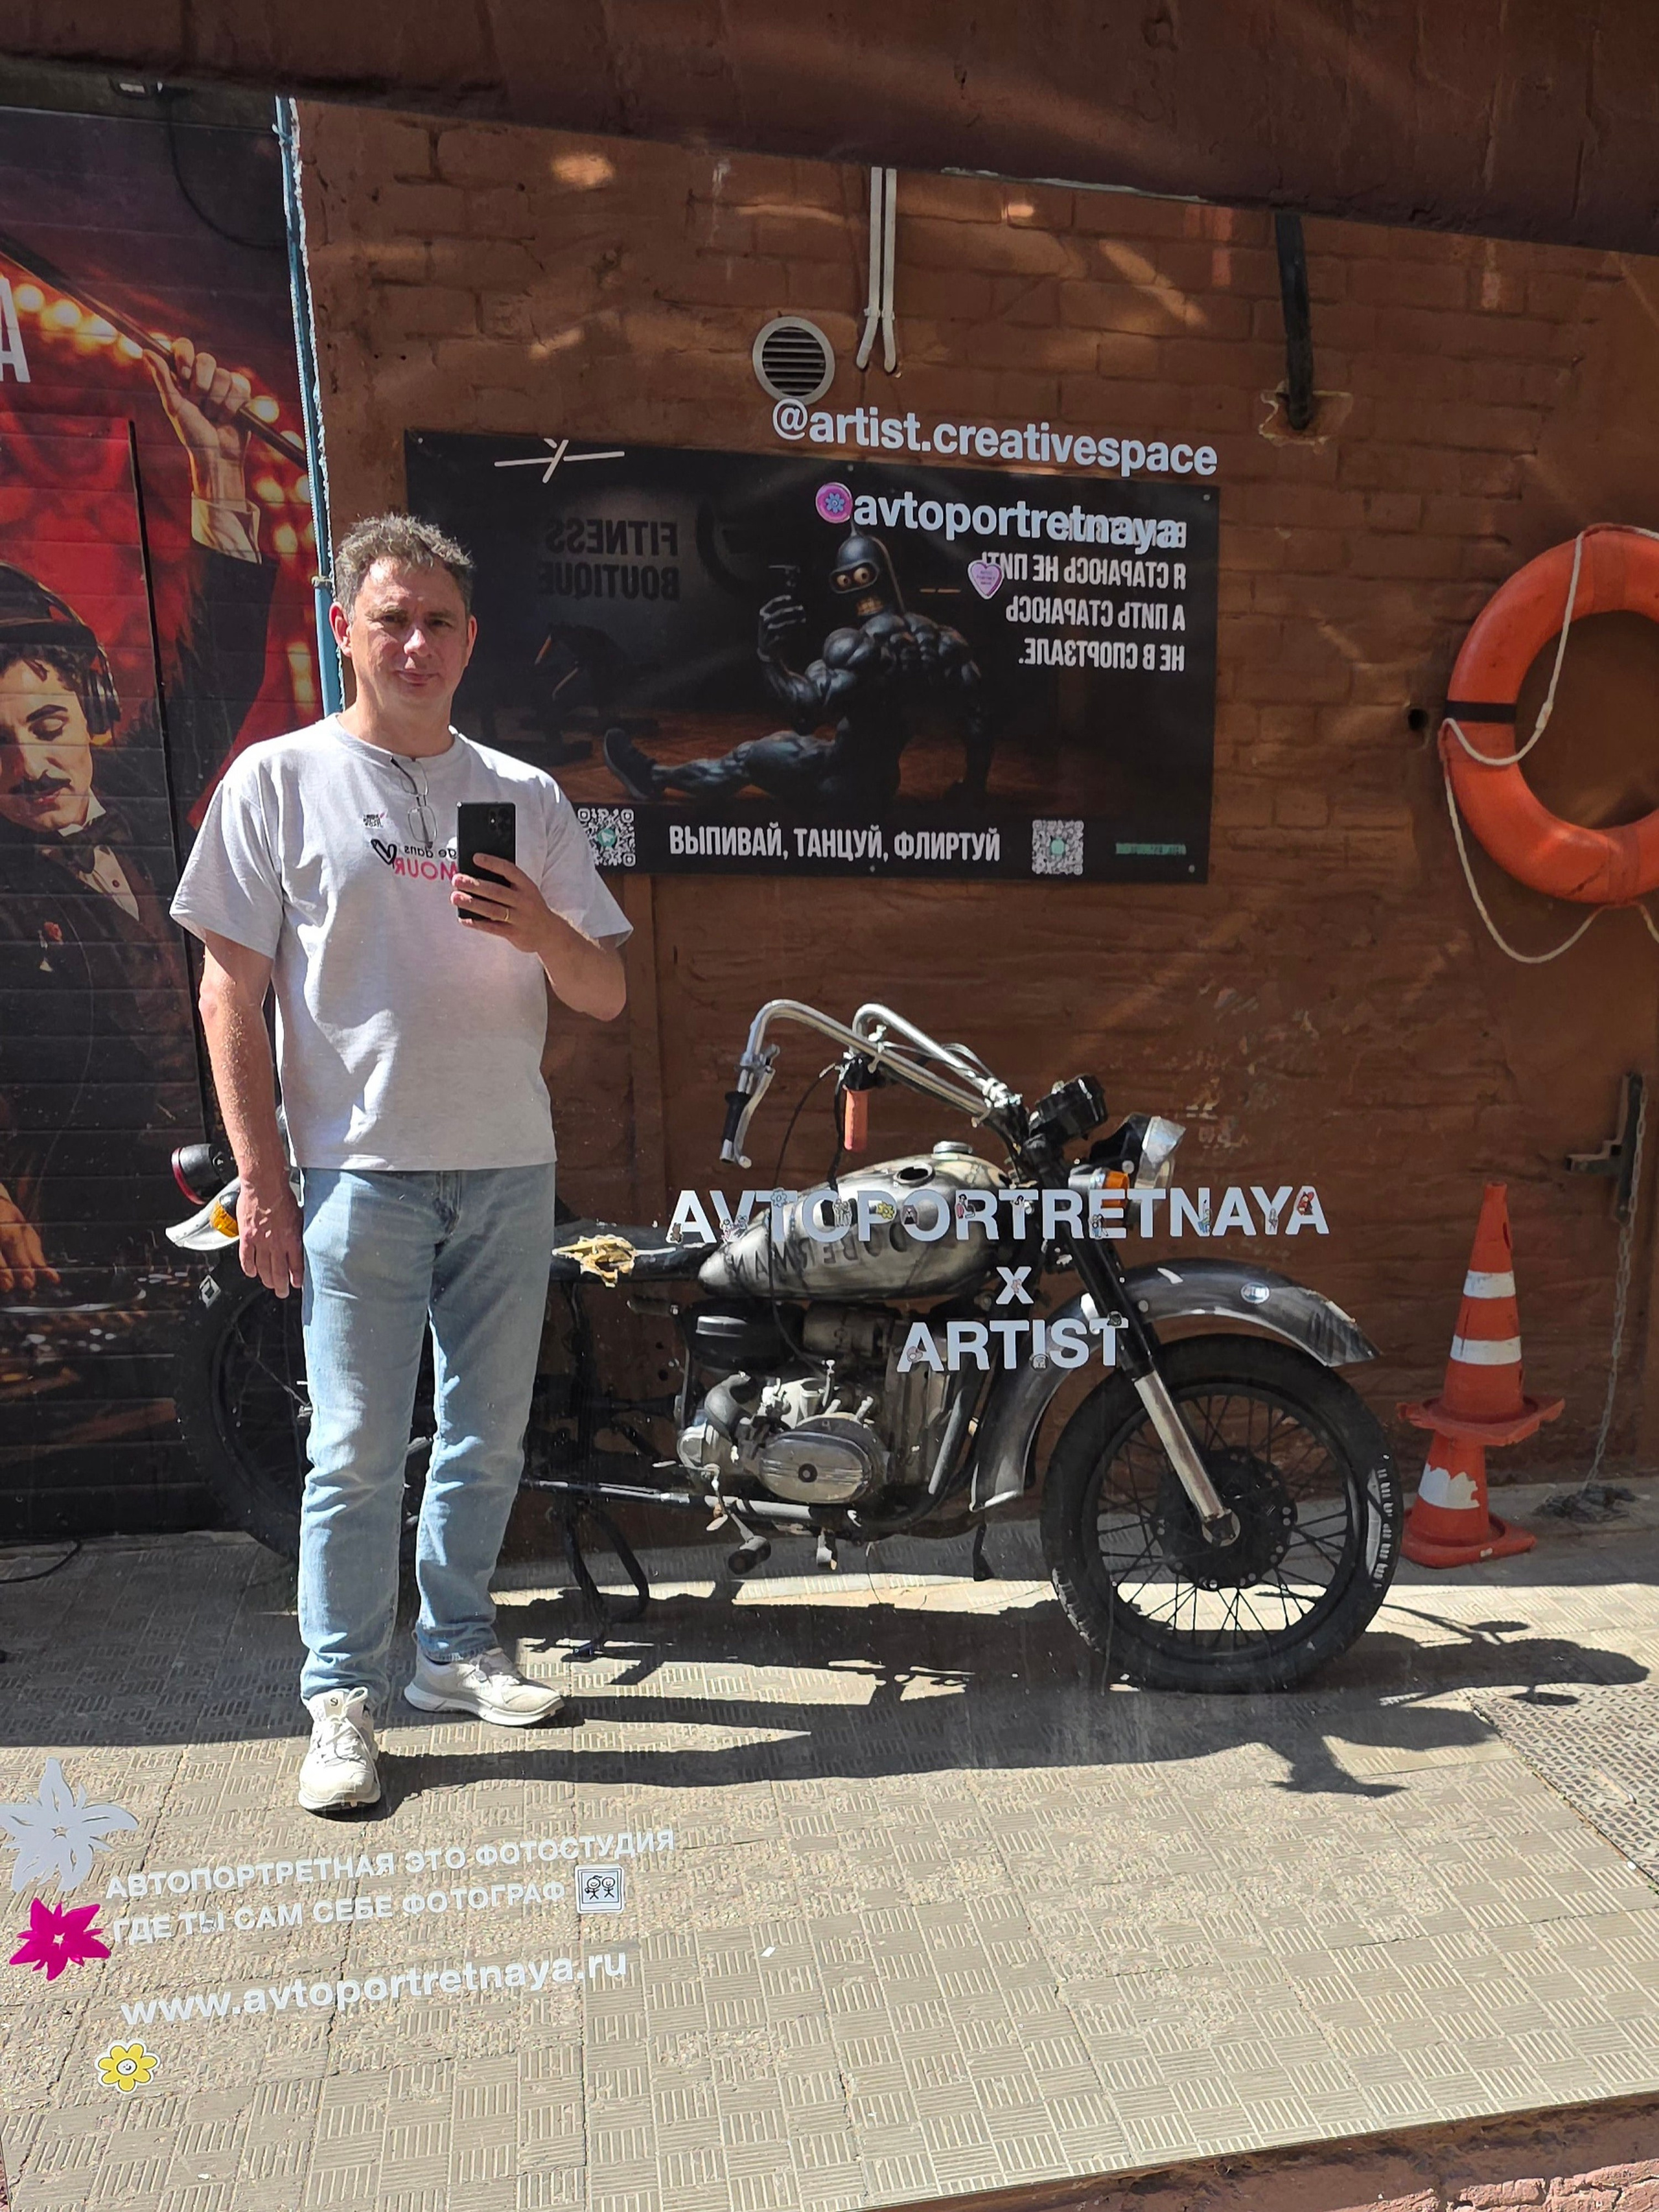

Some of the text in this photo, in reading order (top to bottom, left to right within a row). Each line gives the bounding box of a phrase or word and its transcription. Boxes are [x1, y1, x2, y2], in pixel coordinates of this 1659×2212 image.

[772, 397, 1218, 478] @artist.creativespace
[853, 491, 1178, 555] avtoportretnaya
[669, 822, 1001, 863] ВЫПИВАЙ, ТАНЦУЙ, ФЛИРТУЙ
[666, 1185, 1330, 1244] AVTOPORTRETNAYA
[896, 1318, 1129, 1373] ARTIST
[106, 1829, 674, 1900] АВТОПОРТРЕТНАЯ ЭТО ФОТОСТУДИЯ
[113, 1915, 172, 1945] ГДЕ
[234, 1903, 303, 1930] САМ
[312, 1895, 393, 1924] СЕБЕ
[402, 1881, 565, 1915] ФОТОГРАФ
[121, 1951, 627, 2026] www.avtoportretnaya.ru
